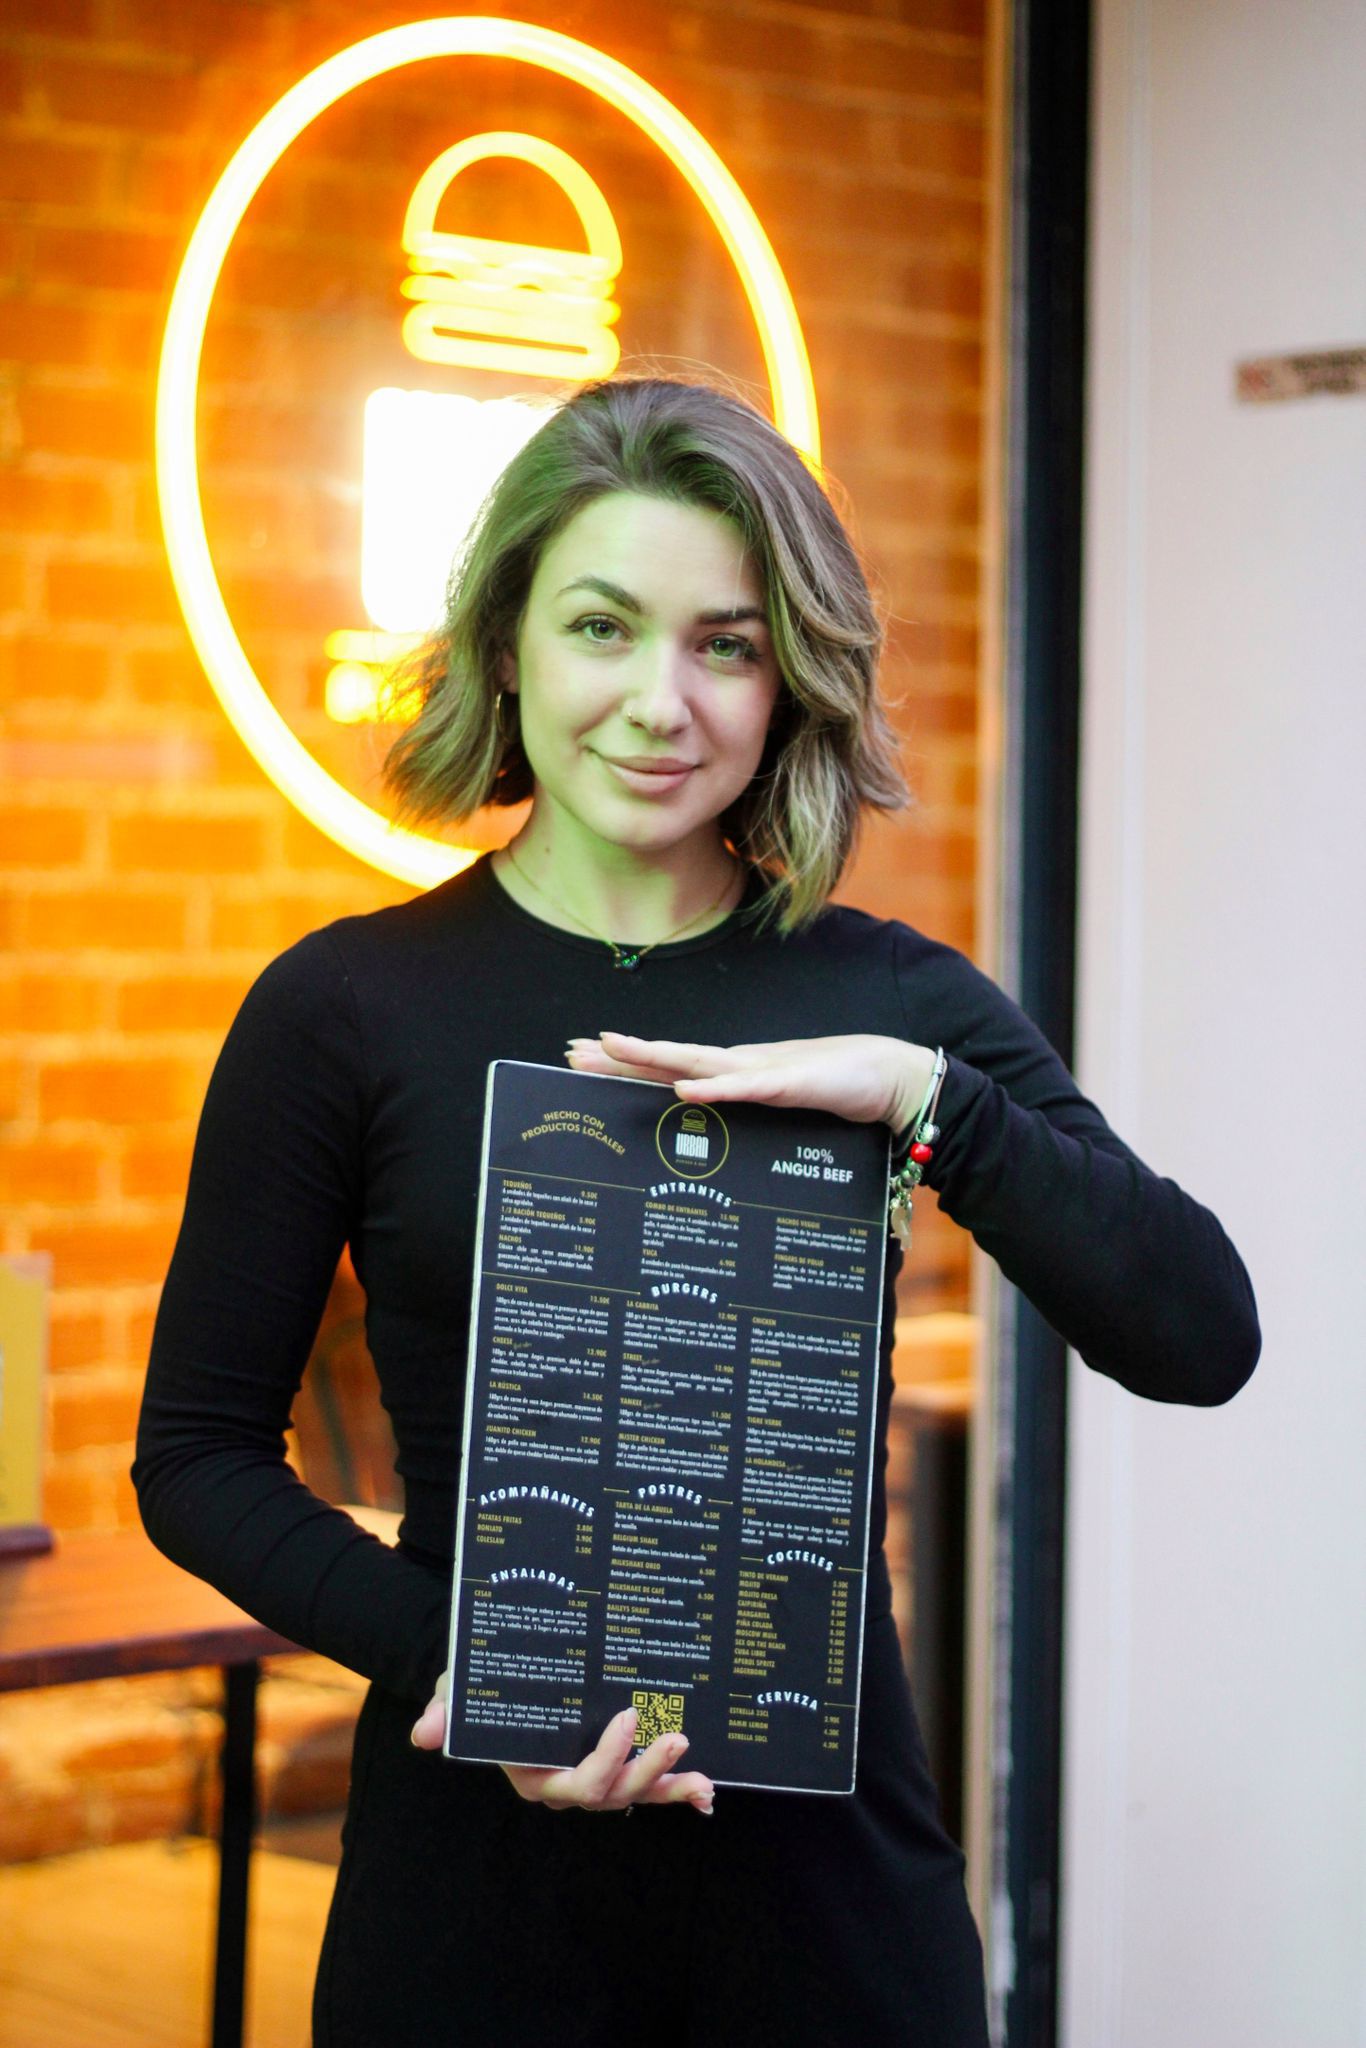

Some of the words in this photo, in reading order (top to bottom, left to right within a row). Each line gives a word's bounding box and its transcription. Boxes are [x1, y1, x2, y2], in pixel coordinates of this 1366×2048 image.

[583, 1114, 605, 1130] CON
[521, 1122, 580, 1141] PRODUCTOS
[582, 1126, 626, 1155] LOCALES!
[676, 1133, 709, 1159] URBAN
[796, 1146, 834, 1164] 100%
[771, 1160, 820, 1179] ANGUS
[823, 1166, 853, 1183] BEEF
[503, 1178, 532, 1190] TEQUEÑOS
[649, 1182, 732, 1207] ENTRANTES
[536, 1209, 565, 1220] TEQUEÑOS
[675, 1205, 708, 1216] ENTRANTES
[498, 1233, 522, 1243] NACHOS
[651, 1281, 718, 1303] BURGERS
[492, 1336, 513, 1345] CHEESE
[489, 1380, 496, 1388] LA
[511, 1427, 536, 1437] CHICKEN
[638, 1484, 703, 1504] POSTRES
[480, 1485, 595, 1517] ACOMPAÑANTES
[477, 1512, 501, 1521] PATATAS
[502, 1515, 522, 1524] FRITAS
[476, 1535, 504, 1544] COLESLAW
[767, 1550, 833, 1571] COCTELES
[491, 1567, 575, 1591] ENSALADAS
[474, 1589, 492, 1597] CESAR
[605, 1624, 620, 1632] TRES
[621, 1626, 640, 1634] LECHES
[470, 1638, 487, 1646] TIGRE
[603, 1664, 637, 1674] CHEESECAKE
[478, 1688, 499, 1697] CAMPO
[757, 1691, 818, 1711] CERVEZA
